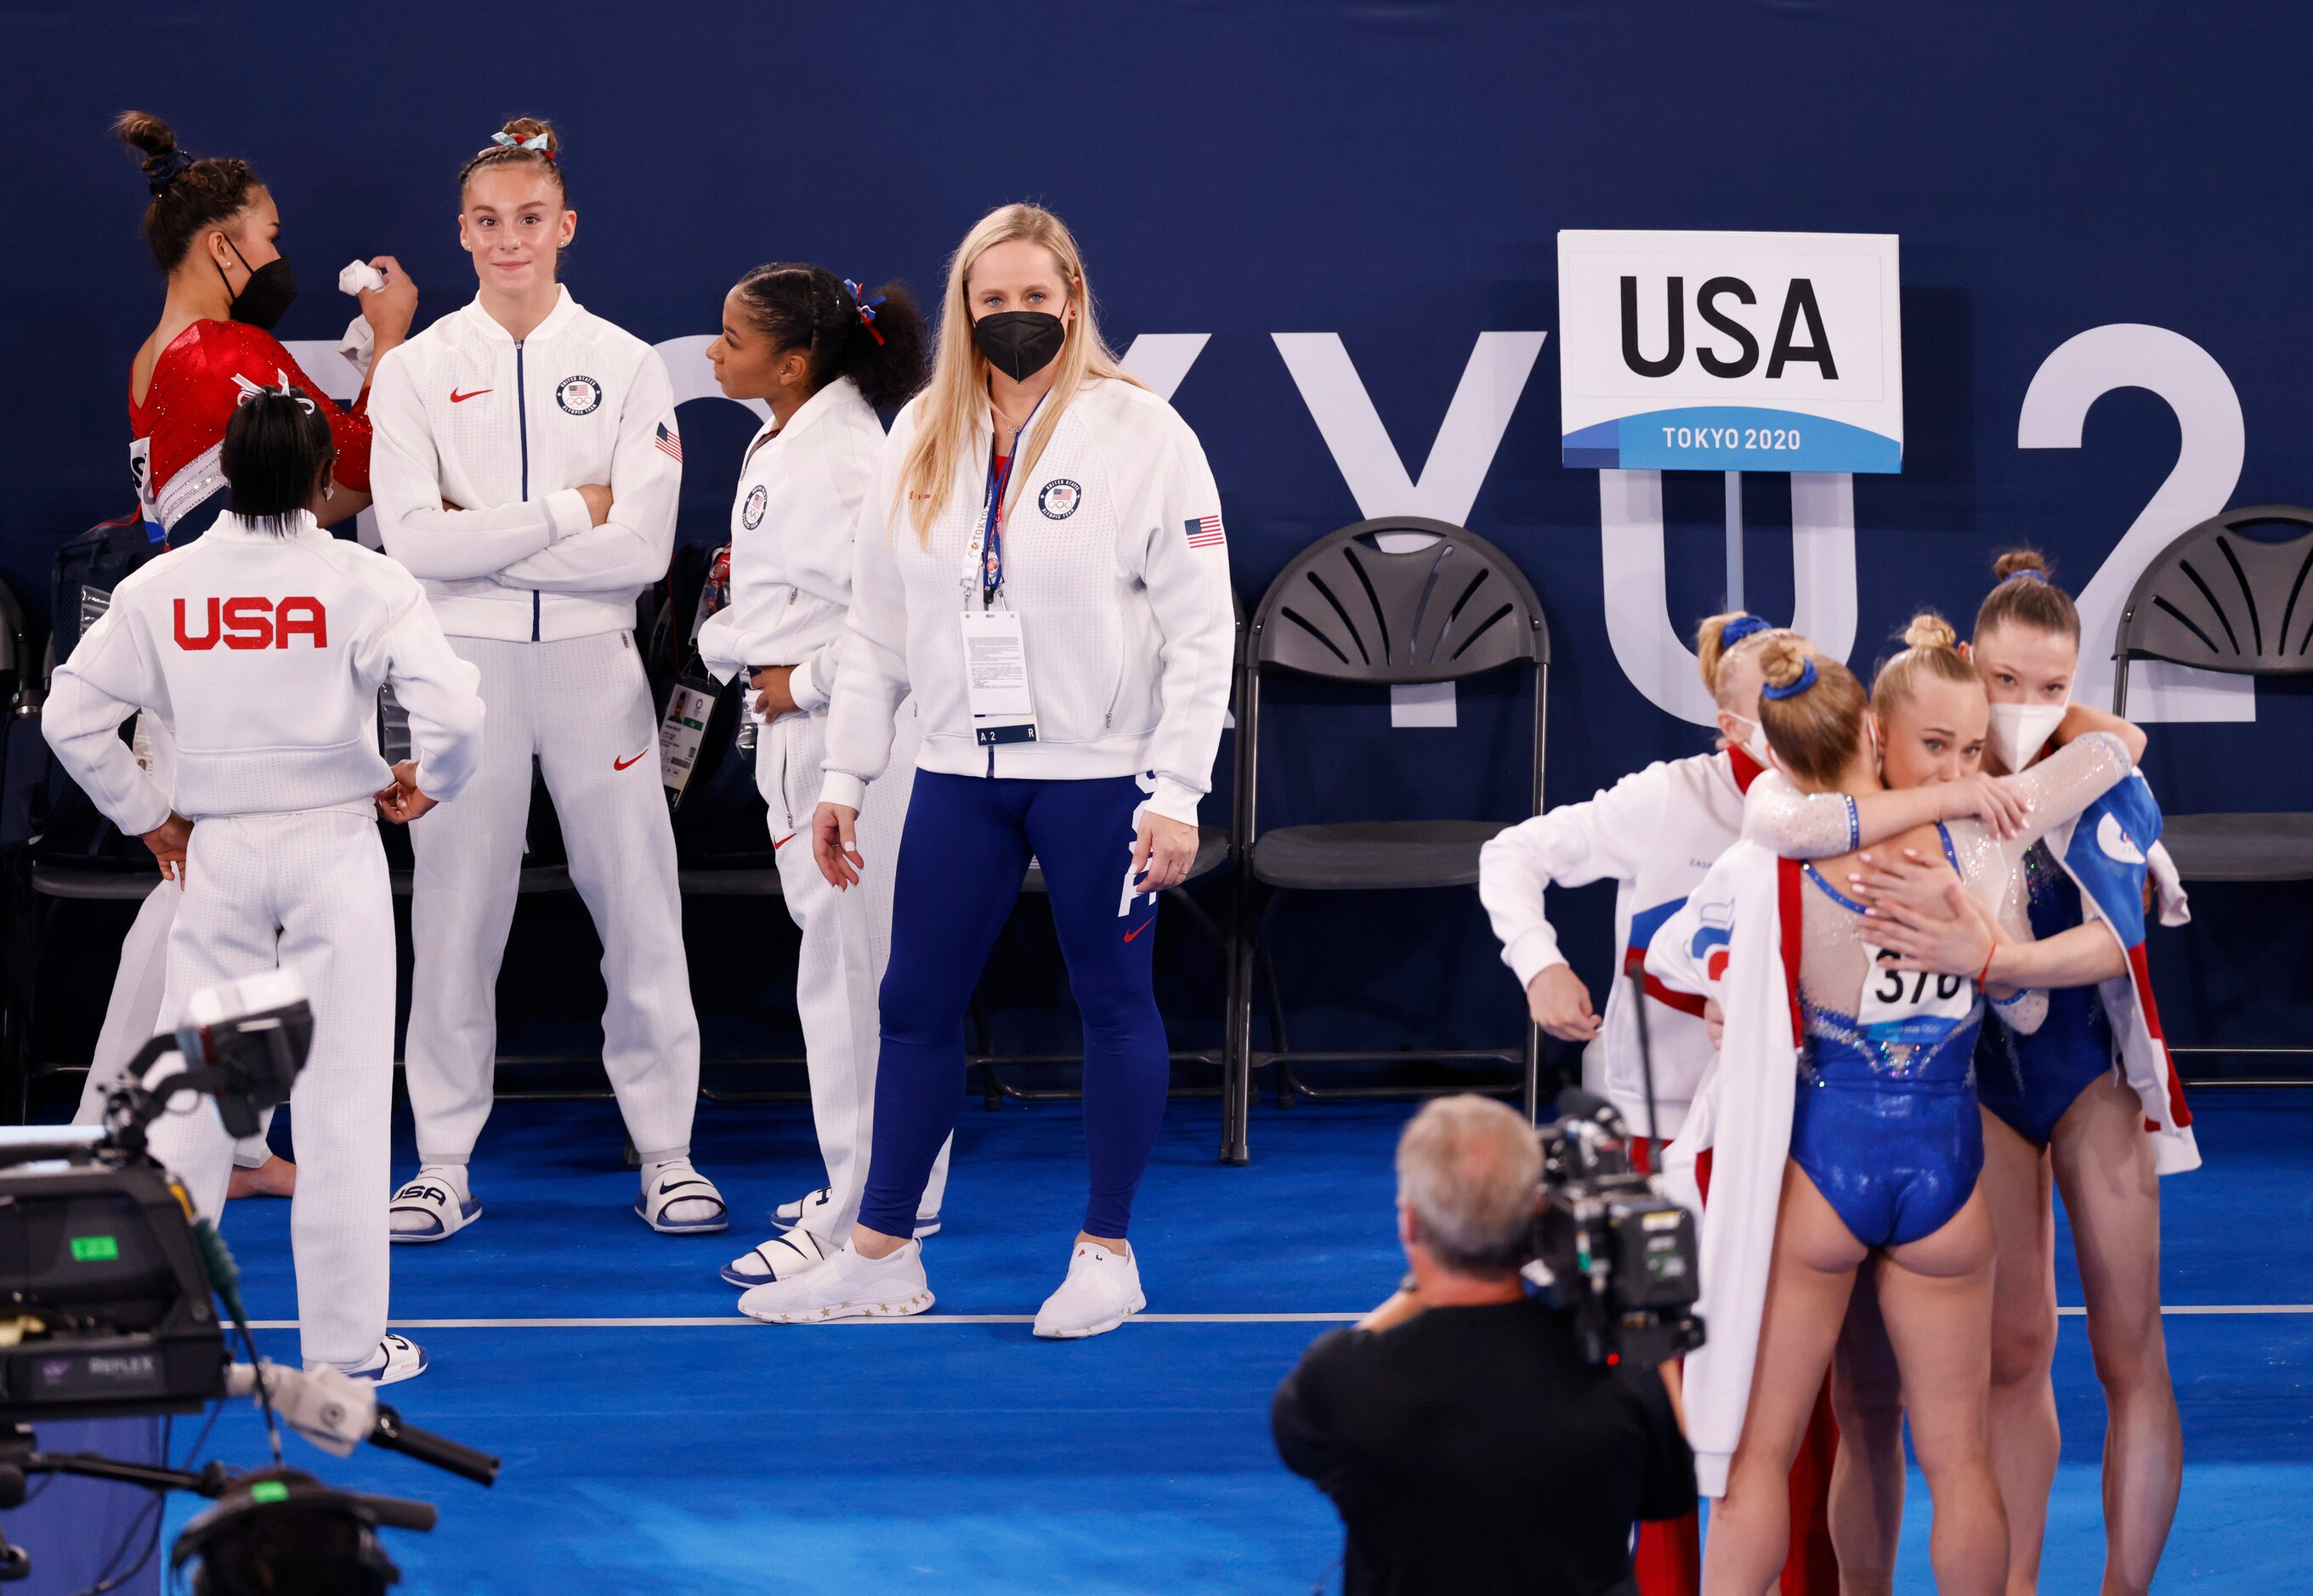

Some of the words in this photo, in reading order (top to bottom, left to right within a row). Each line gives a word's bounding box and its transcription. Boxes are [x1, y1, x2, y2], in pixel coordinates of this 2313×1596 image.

[1620, 276, 1839, 380] USA
[1663, 427, 1739, 449] TOKYO
[1745, 429, 1800, 450] 2020
[972, 509, 989, 540] TOKYO
[173, 596, 327, 650] USA
[1028, 728, 1035, 738] R
